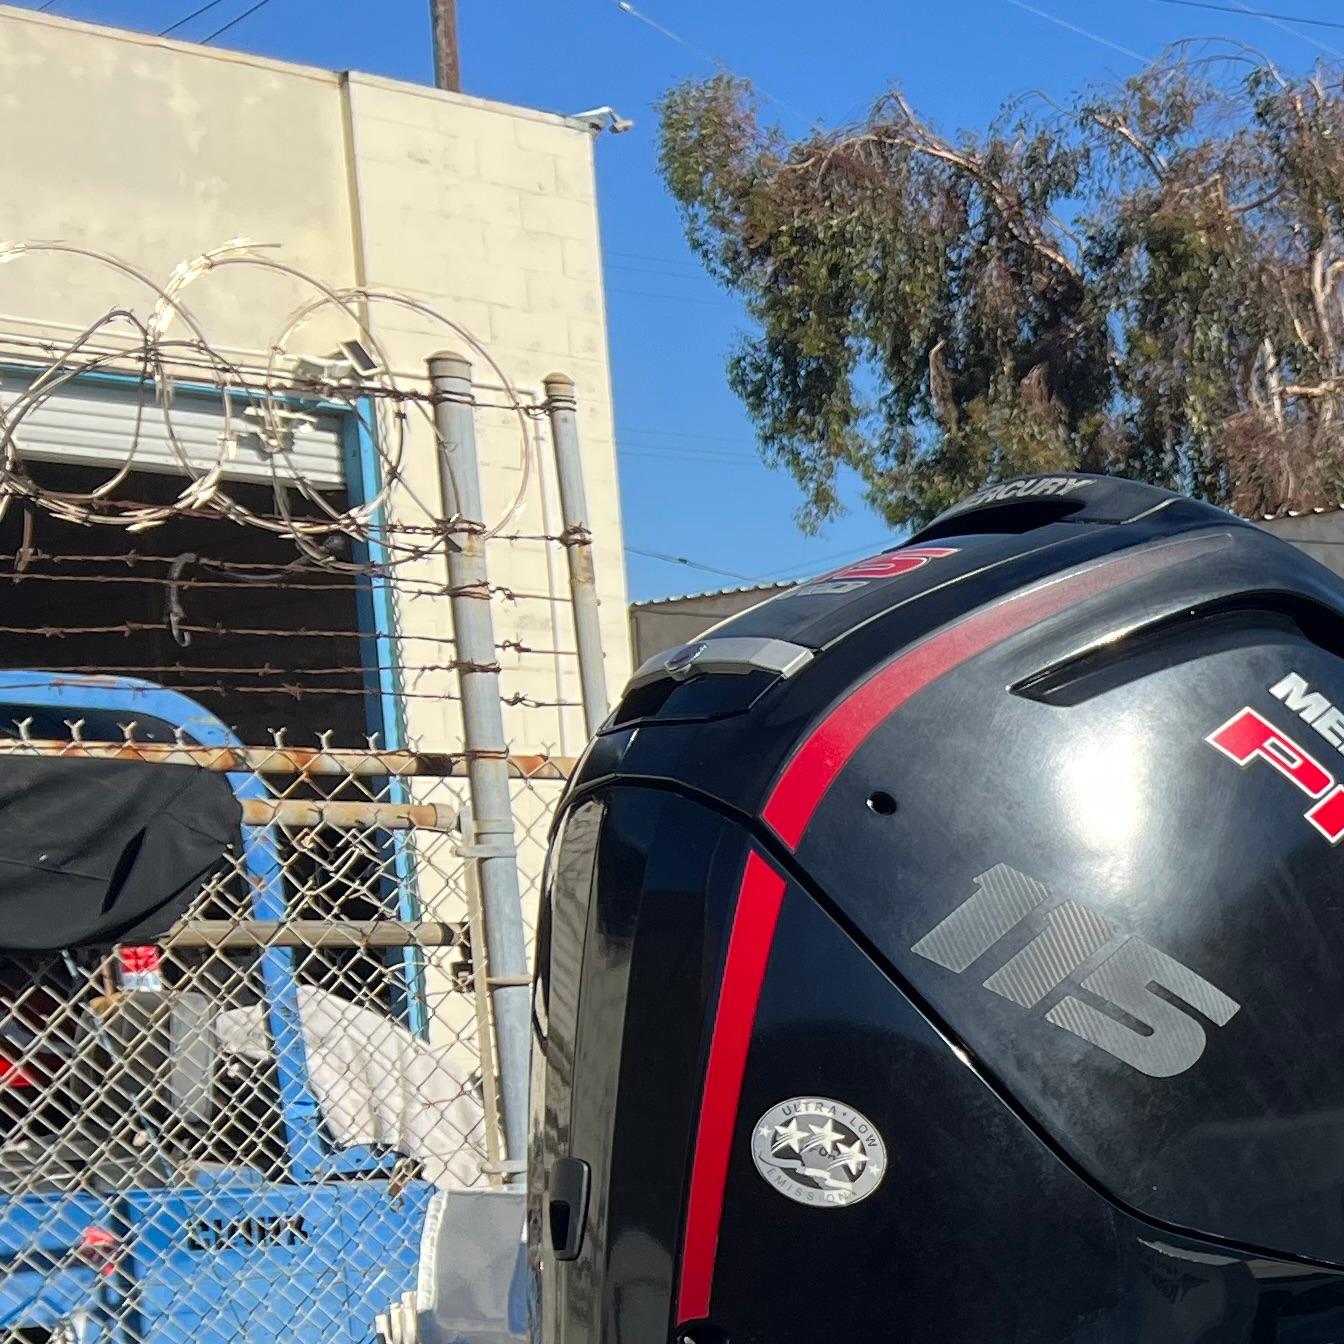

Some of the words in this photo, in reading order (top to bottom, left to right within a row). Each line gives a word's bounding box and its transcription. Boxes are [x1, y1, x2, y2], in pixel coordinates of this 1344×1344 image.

[910, 862, 1241, 1078] 115
[781, 1101, 836, 1116] ULTRA
[849, 1116, 878, 1148] LOW
